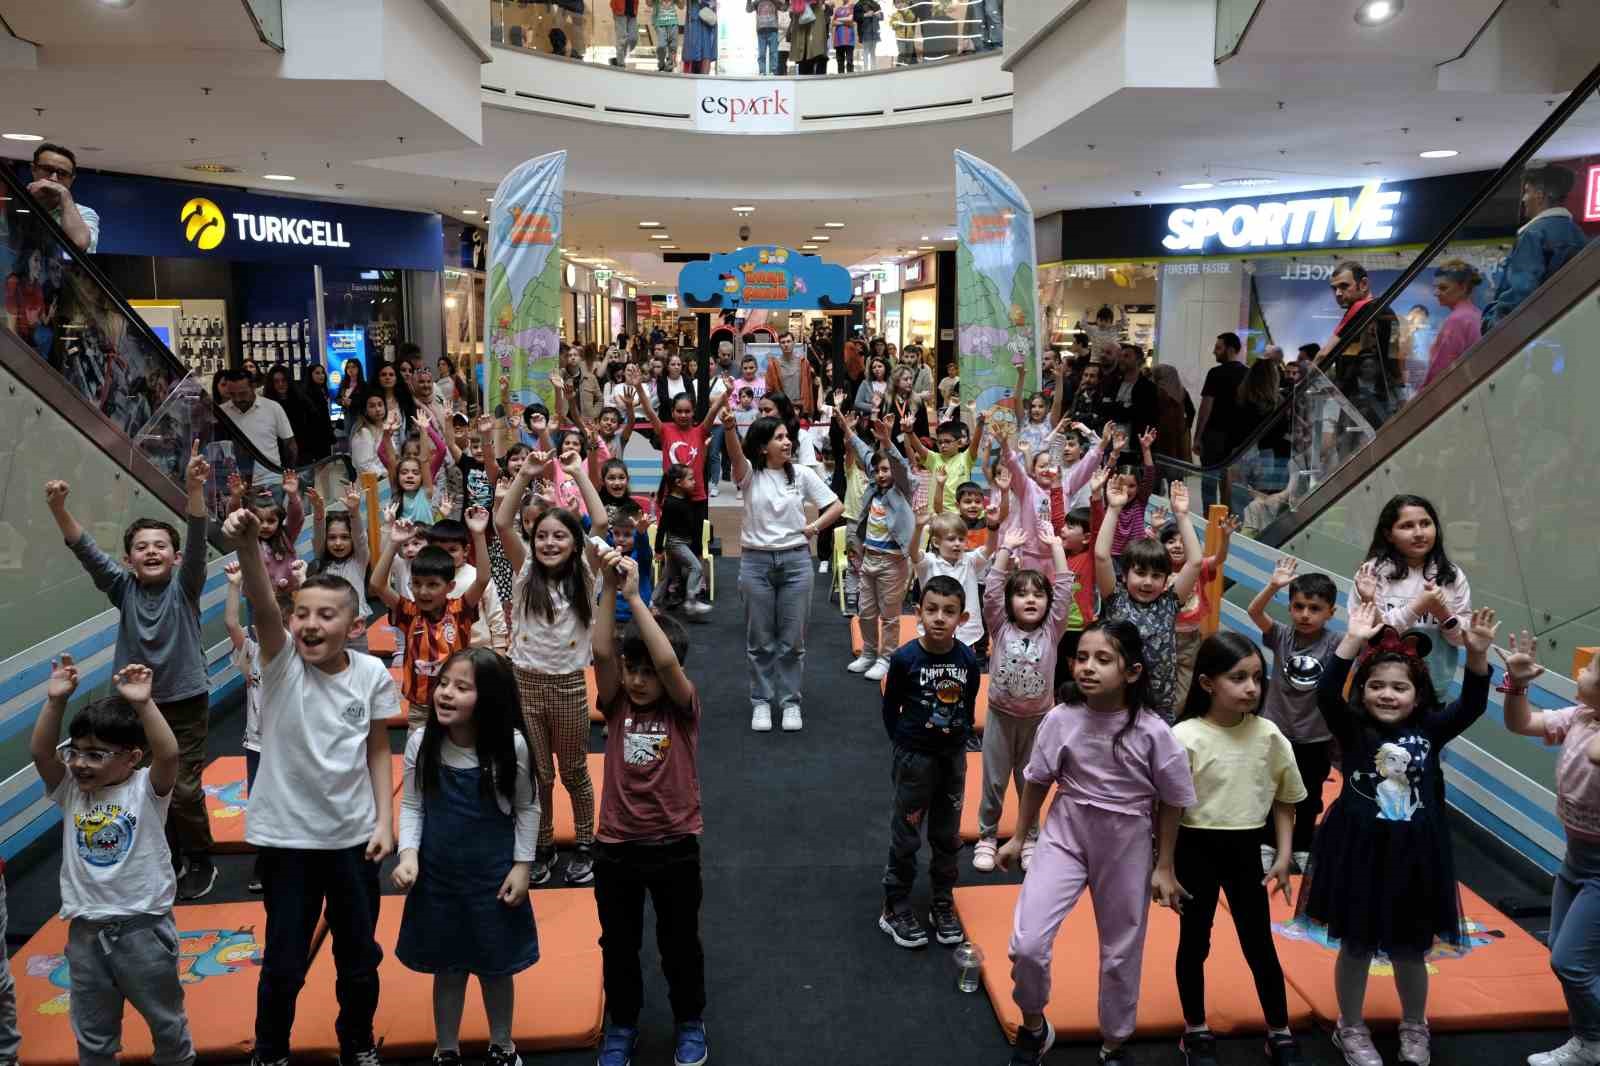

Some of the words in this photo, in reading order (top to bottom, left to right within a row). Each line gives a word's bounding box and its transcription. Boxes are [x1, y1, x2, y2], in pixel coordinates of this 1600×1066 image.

[701, 89, 789, 122] espark
[233, 213, 351, 248] TURKCELL
[1162, 180, 1401, 250] SPORTIVE
